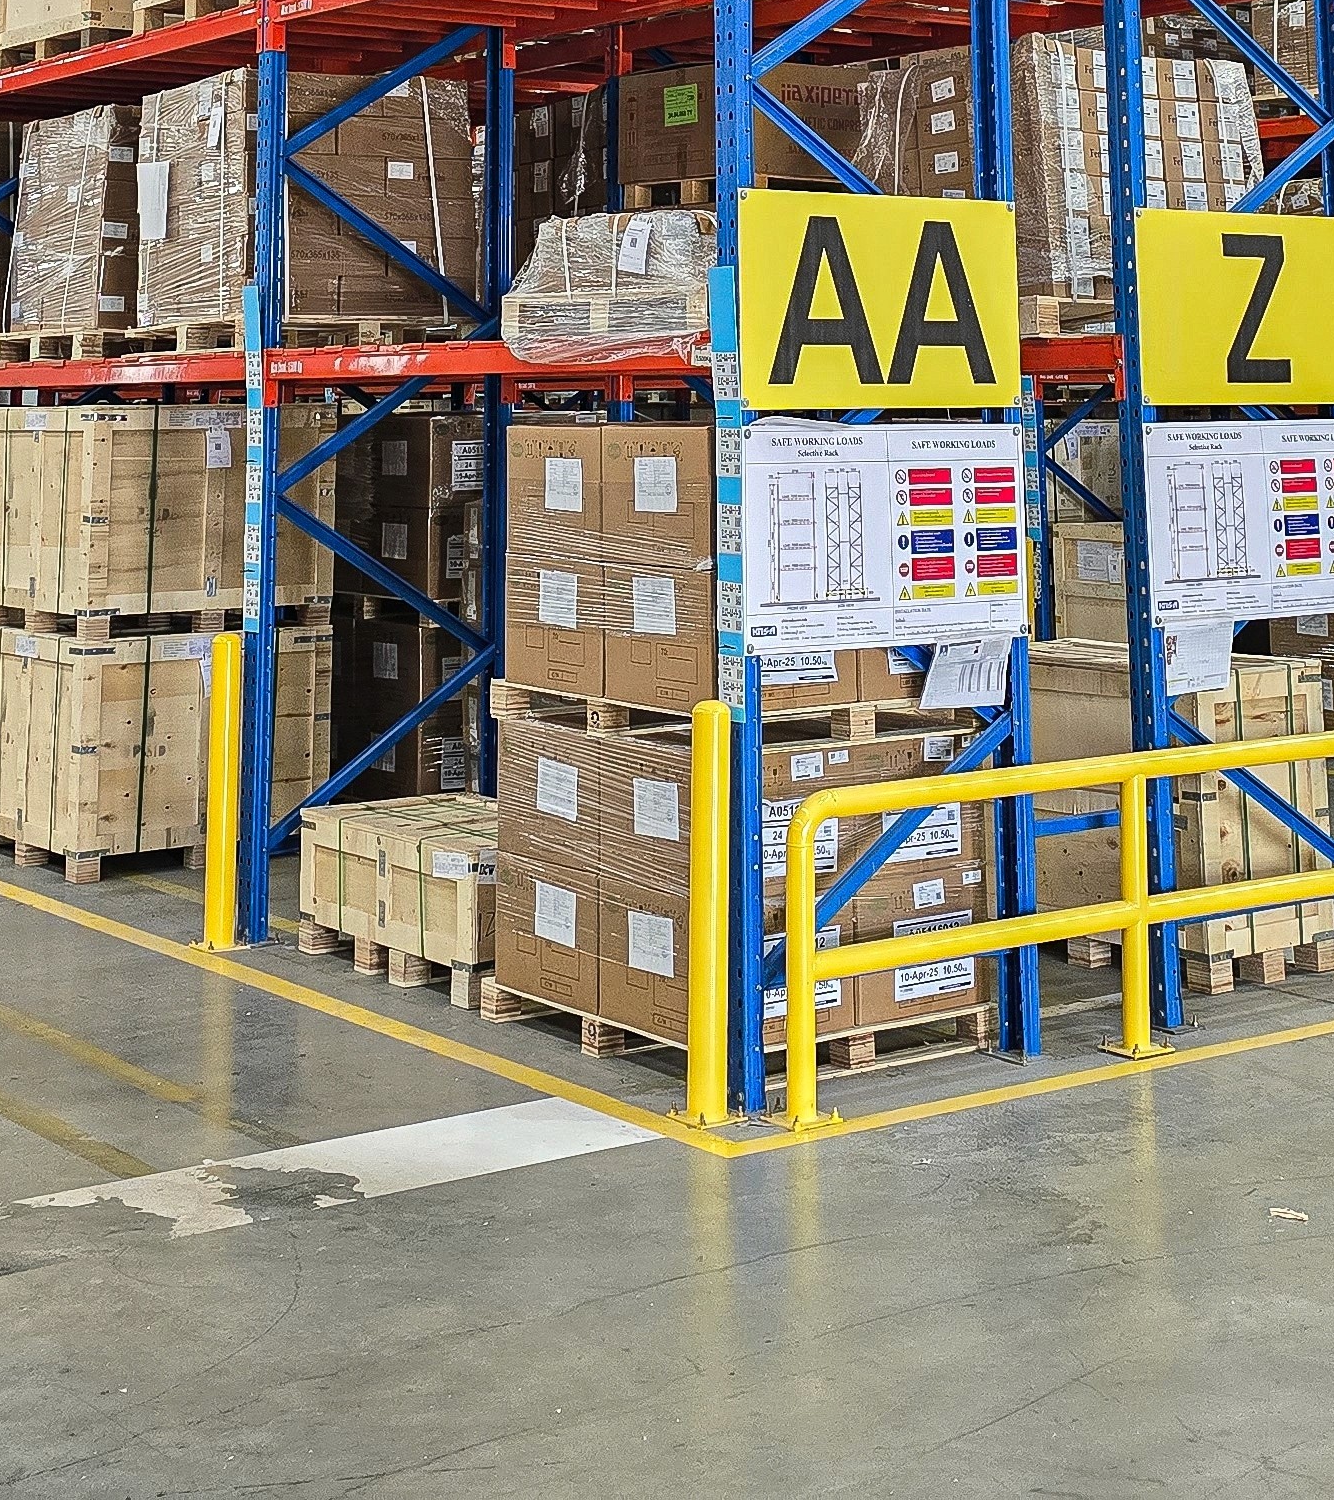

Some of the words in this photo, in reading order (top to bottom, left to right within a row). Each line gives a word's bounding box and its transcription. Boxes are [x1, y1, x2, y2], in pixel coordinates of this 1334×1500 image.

[768, 216, 996, 384] AA
[1222, 233, 1292, 384] Z
[772, 437, 793, 447] SAFE
[794, 437, 834, 447] WORKING
[837, 436, 863, 446] LOADS
[912, 440, 931, 450] SAFE
[932, 440, 970, 449] WORKING
[971, 439, 996, 449] LOADS
[769, 805, 798, 818] A051
[773, 831, 783, 841] 24
[764, 846, 786, 860] 0-Apr
[900, 966, 939, 983] 10-Apr-25
